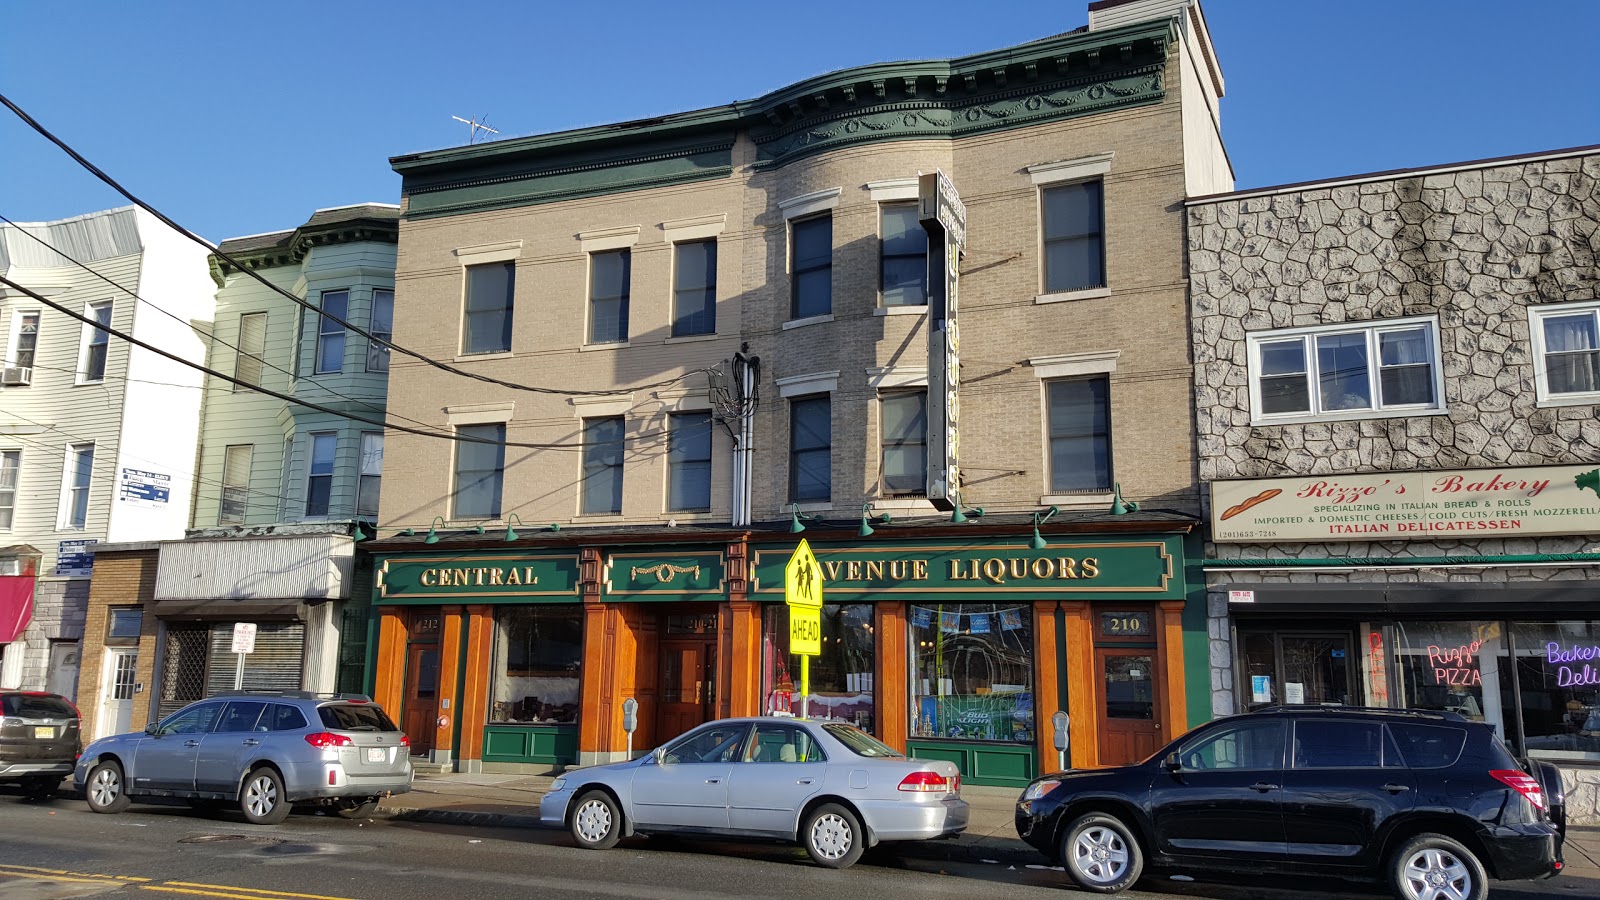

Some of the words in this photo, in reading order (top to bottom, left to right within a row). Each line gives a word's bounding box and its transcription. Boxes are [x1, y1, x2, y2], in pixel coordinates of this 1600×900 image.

[1296, 479, 1406, 504] Rizzo's
[1432, 474, 1551, 497] Bakery
[1314, 504, 1380, 513] SPECIALIZING
[1402, 502, 1438, 510] ITALIAN
[1498, 499, 1531, 507] ROLLS
[1254, 517, 1303, 525] IMPORTED
[1320, 514, 1371, 523] DOMESTIC
[1329, 523, 1389, 534] ITALIAN
[1397, 520, 1521, 532] DELICATESSEN
[1219, 530, 1277, 538] (201)653-7248
[421, 566, 538, 586] CENTRAL
[950, 557, 1099, 584] LIQUORS
[422, 619, 438, 629] 212
[688, 619, 718, 629] 210-21
[792, 618, 819, 642] AHEAD
[1111, 618, 1140, 631] 210
[1427, 639, 1483, 668] Rizzo
[1547, 641, 1600, 663] Baker
[1369, 632, 1388, 702] OPEN
[1558, 664, 1600, 687] Deli
[1435, 668, 1483, 686] PIZZA
[967, 711, 989, 719] BUD
